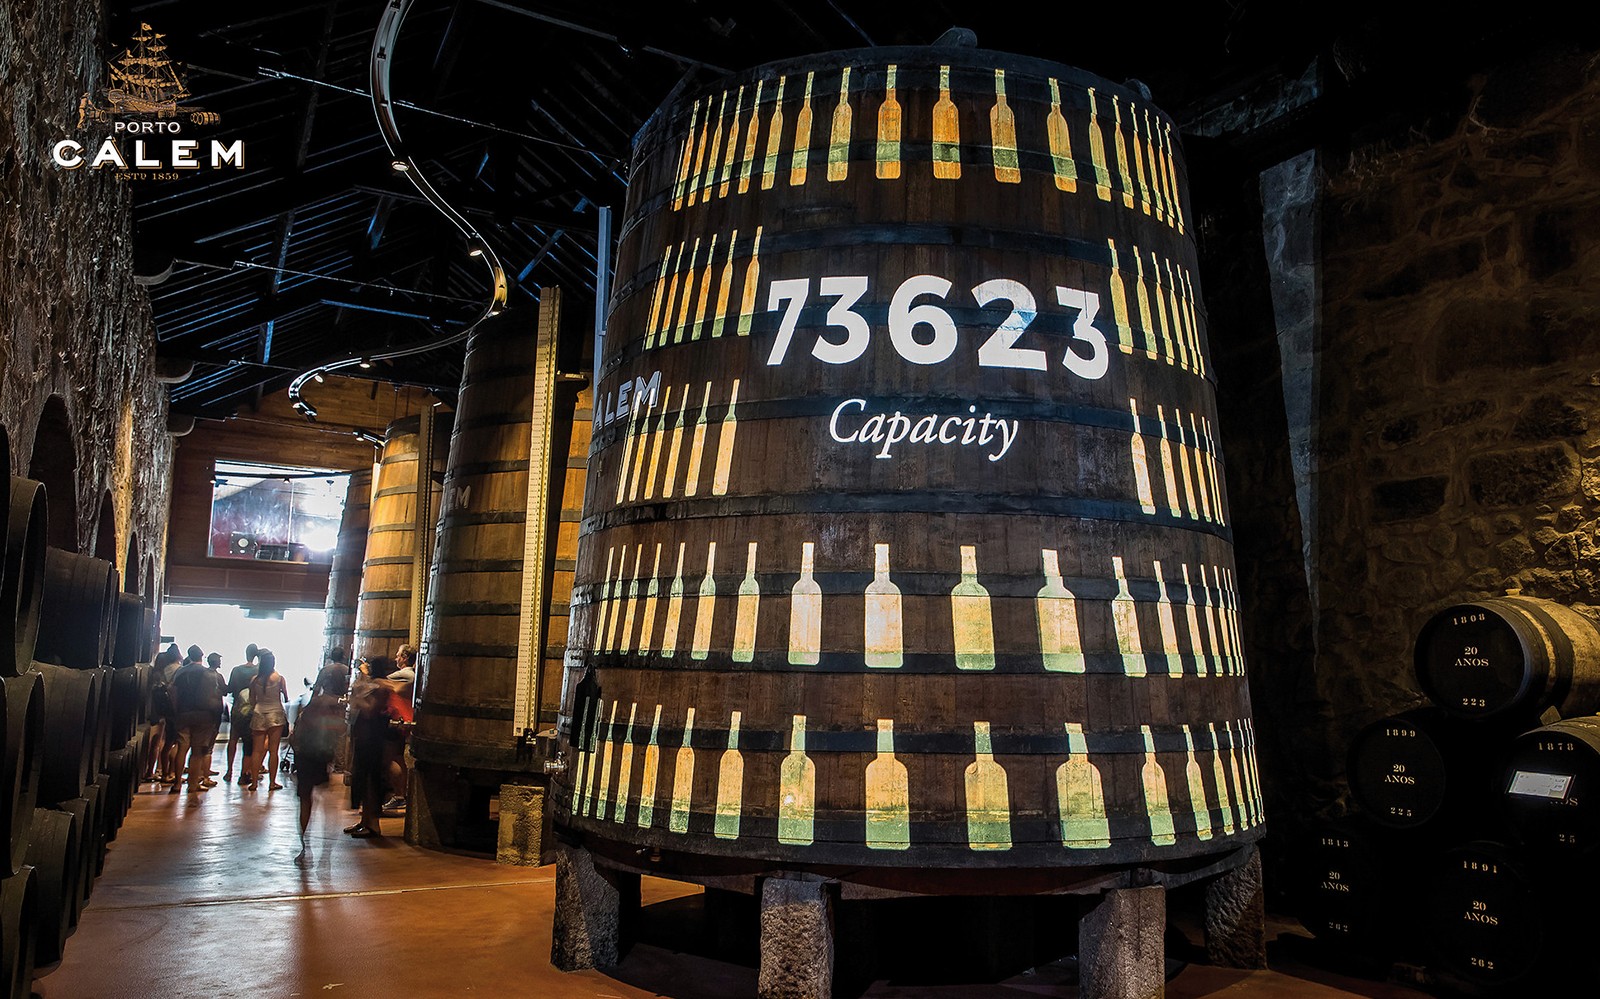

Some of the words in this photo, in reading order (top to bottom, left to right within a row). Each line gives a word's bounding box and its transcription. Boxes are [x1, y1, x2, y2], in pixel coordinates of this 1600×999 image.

[766, 275, 1110, 380] 73623
[829, 398, 1020, 462] Capacity
[1453, 613, 1485, 626] 1808
[1463, 646, 1478, 656] 20
[1454, 658, 1489, 667] ANOS
[1462, 697, 1486, 708] 223
[1385, 728, 1416, 738] 1899
[1538, 742, 1575, 751] 1878
[1392, 764, 1406, 774] 20
[1384, 775, 1415, 785] ANOS
[1390, 806, 1412, 818] 225
[1321, 837, 1350, 848] 1813
[1462, 860, 1498, 874] 1891
[1328, 871, 1341, 880] 20
[1320, 881, 1350, 893] ANOS
[1471, 900, 1487, 911] 20
[1463, 911, 1499, 926] ANOS
[1471, 957, 1494, 970] 262
